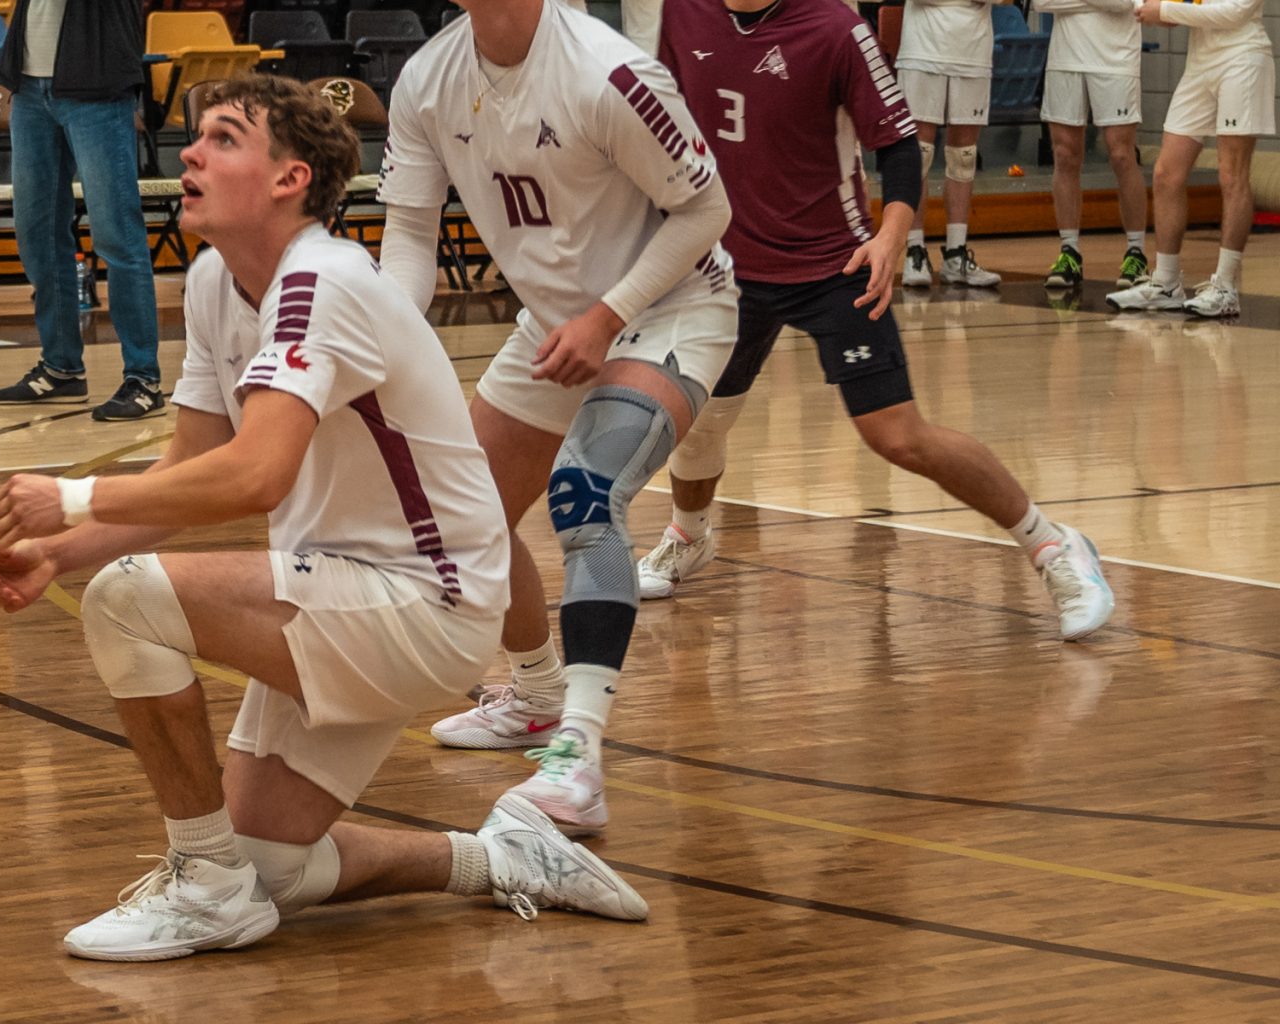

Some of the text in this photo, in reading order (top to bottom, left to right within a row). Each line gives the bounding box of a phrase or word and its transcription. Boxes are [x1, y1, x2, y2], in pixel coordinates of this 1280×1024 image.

[715, 88, 746, 143] 3
[139, 181, 183, 195] SONS
[492, 171, 553, 229] 10
